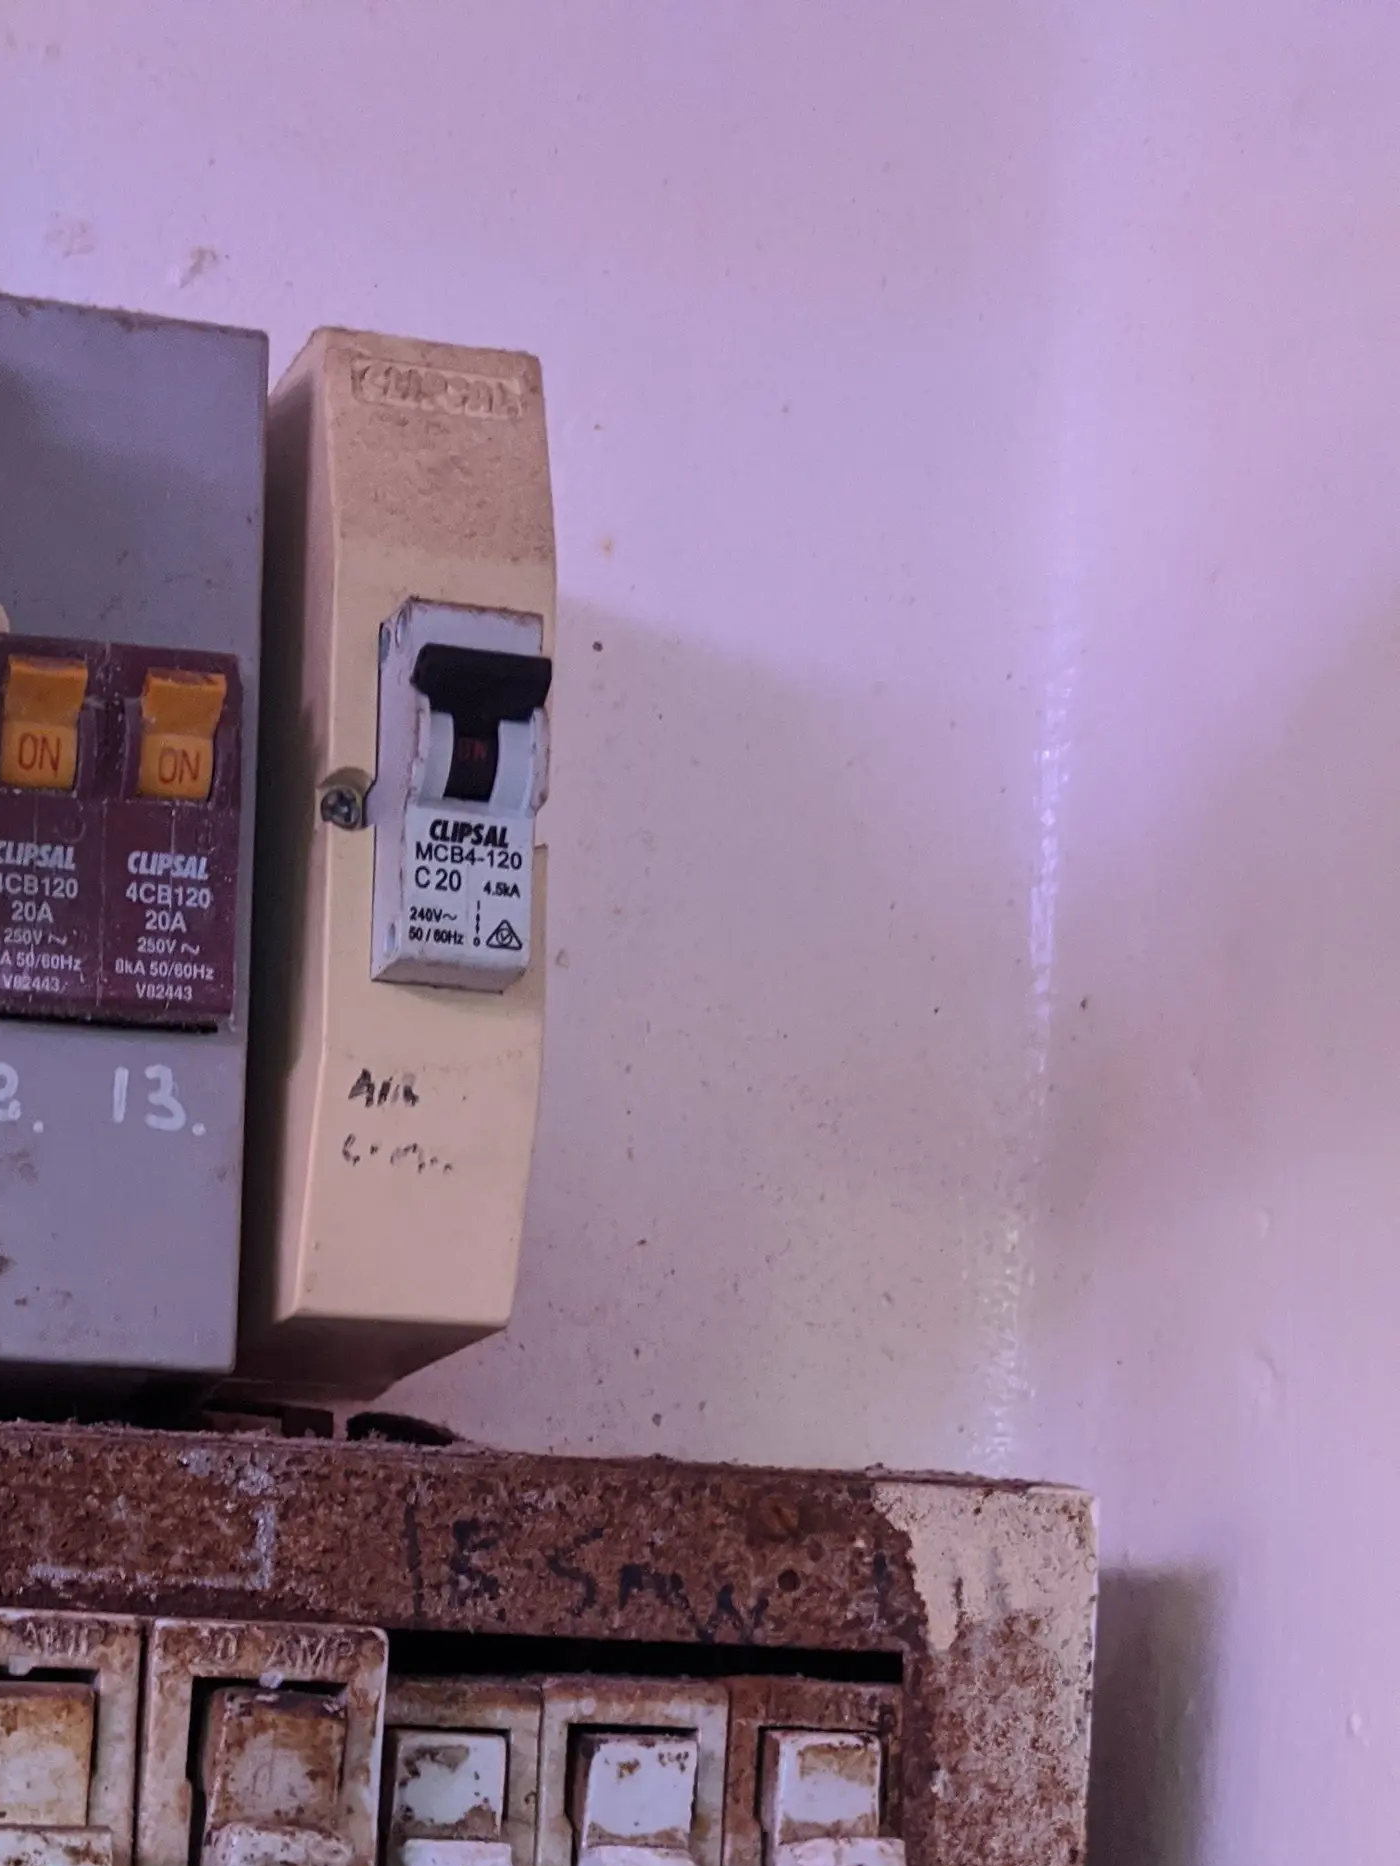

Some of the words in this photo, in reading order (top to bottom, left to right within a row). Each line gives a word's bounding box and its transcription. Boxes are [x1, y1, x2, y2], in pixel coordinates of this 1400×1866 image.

[18, 732, 61, 777] ON
[157, 746, 201, 785] ON
[429, 819, 509, 848] CLIPSAL
[128, 851, 210, 881] CLIPSAL
[415, 841, 522, 870] MCB4-120
[125, 882, 211, 910] 4CB120
[11, 901, 54, 923] 20A
[145, 911, 188, 933] 20A
[4, 928, 43, 945] 250V
[137, 937, 177, 954] 250V
